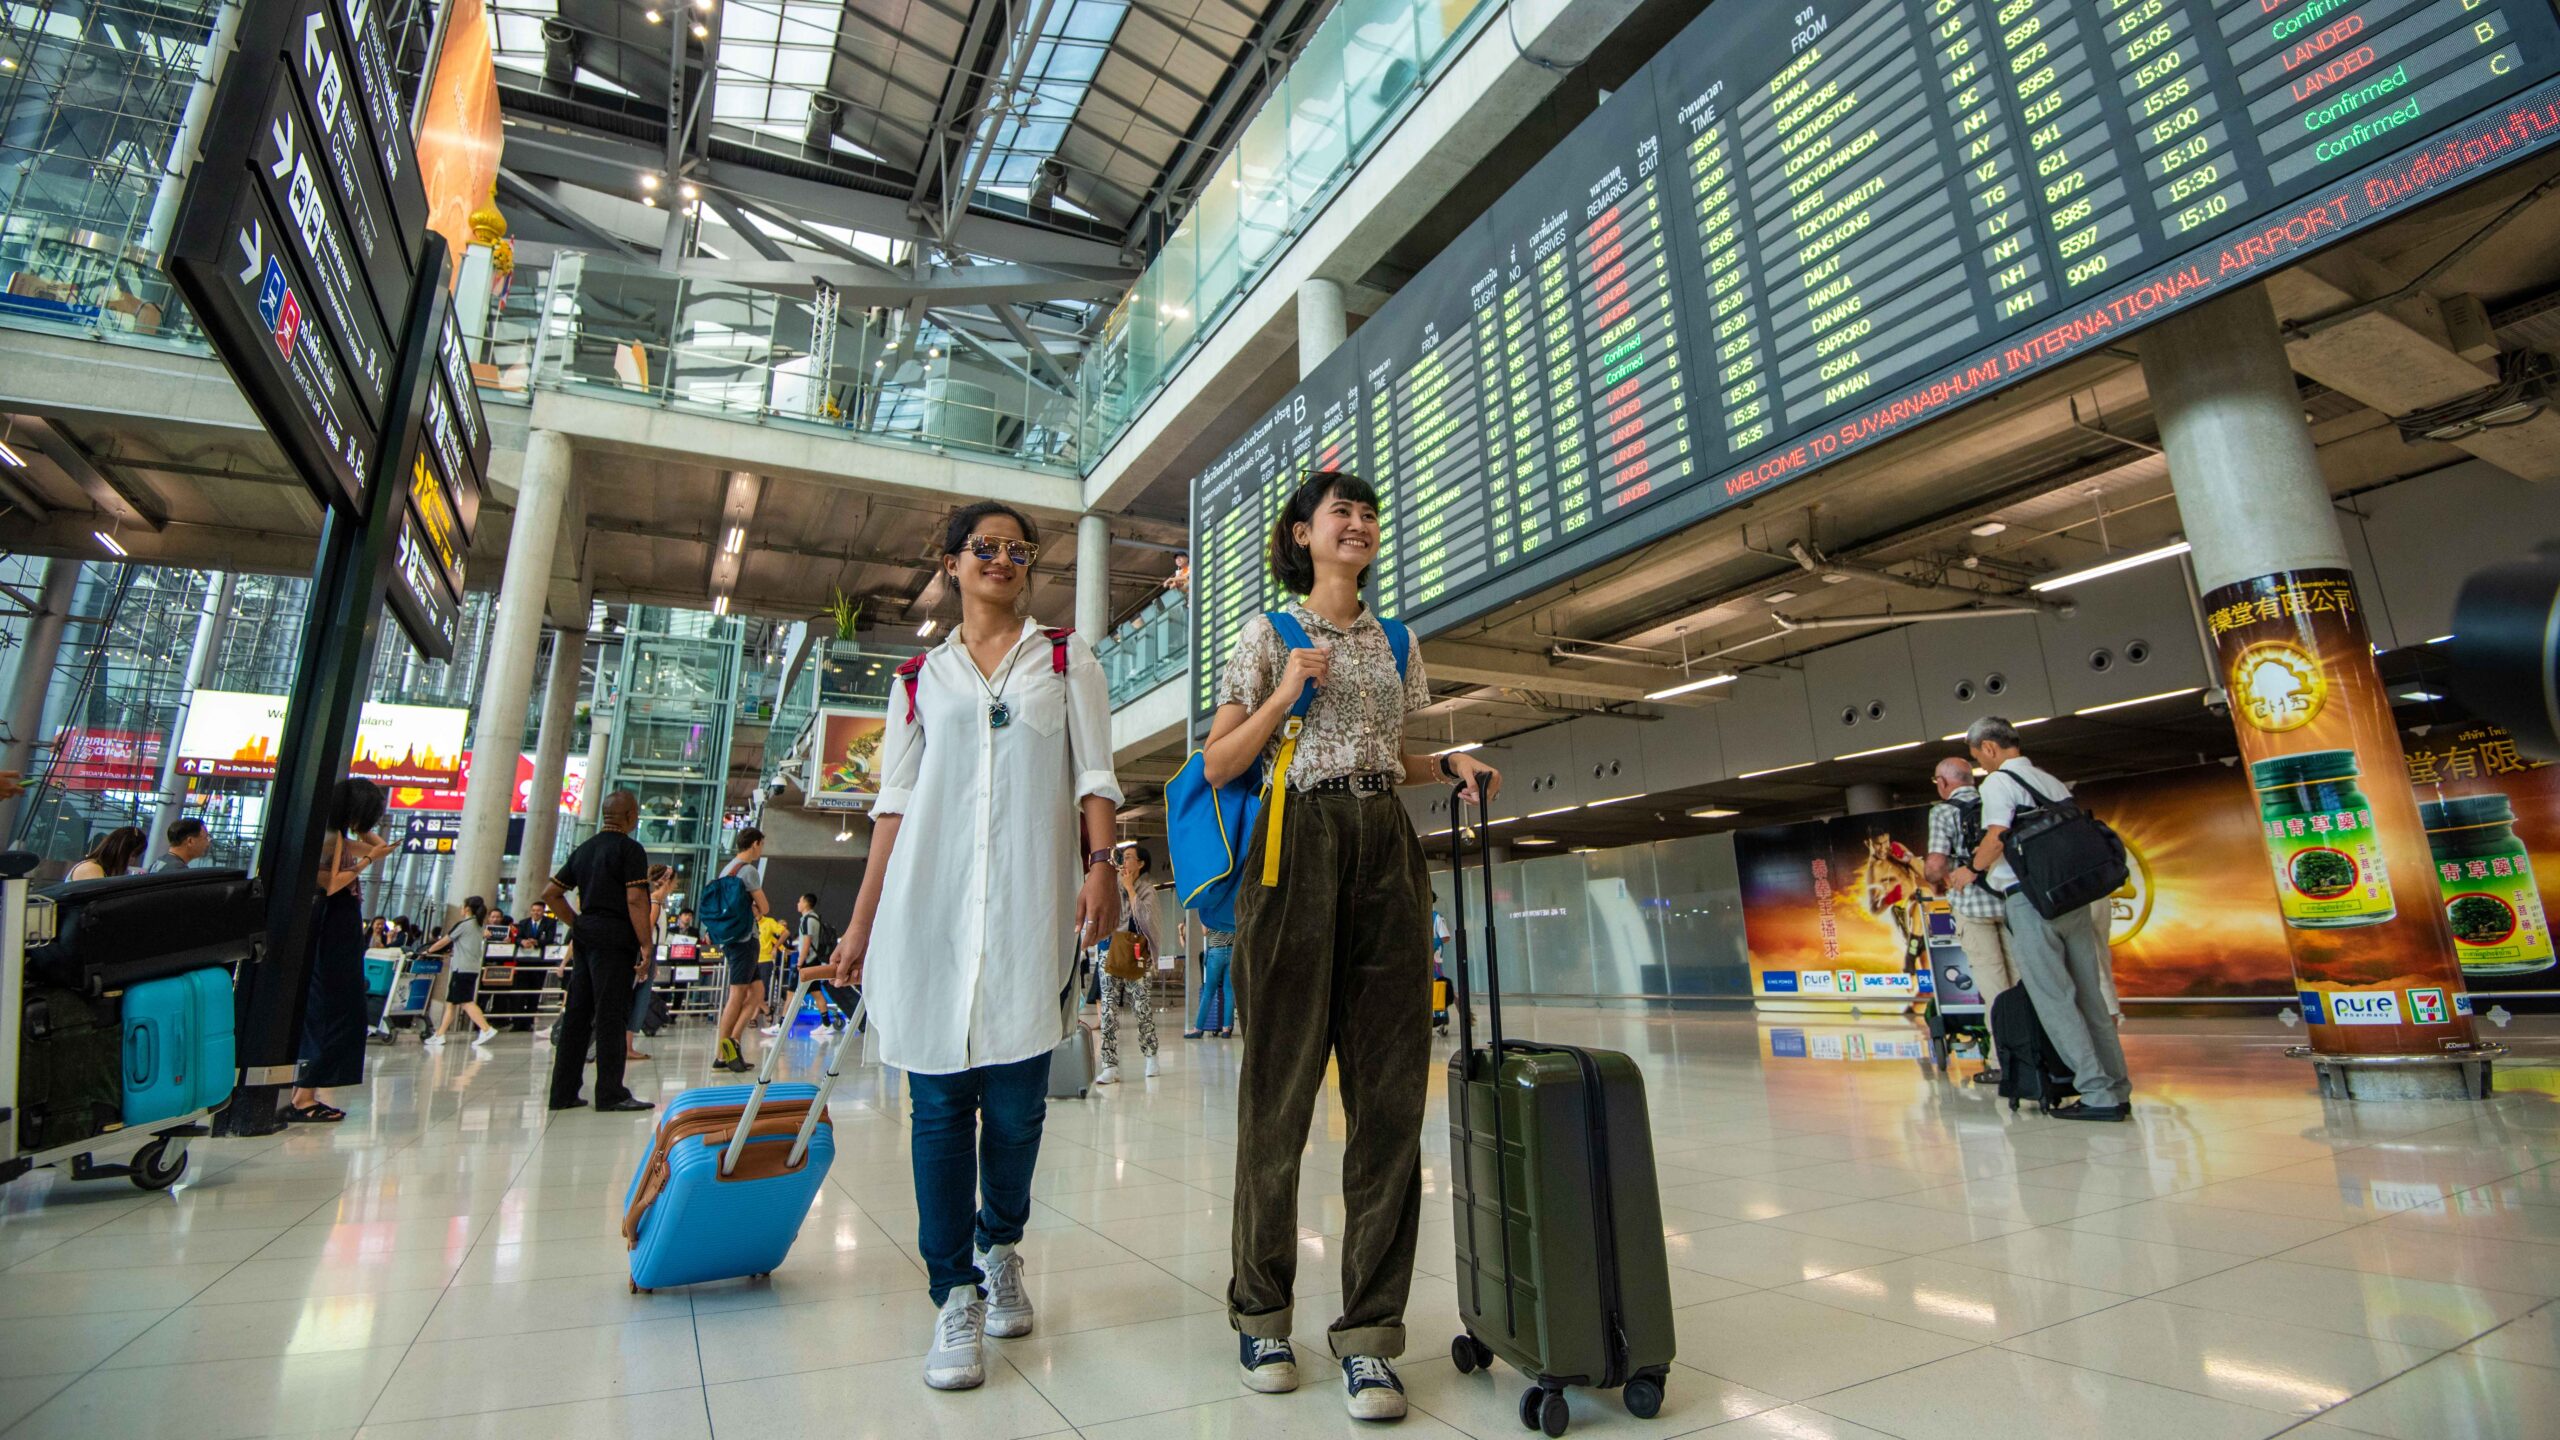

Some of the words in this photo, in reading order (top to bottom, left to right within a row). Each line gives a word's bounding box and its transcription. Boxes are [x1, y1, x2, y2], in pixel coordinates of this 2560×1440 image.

[1795, 6, 1814, 26] จาก
[359, 41, 374, 93] Group
[371, 84, 383, 124] Tour
[1691, 104, 1716, 133] TIME
[1791, 15, 1827, 53] FROM
[1693, 128, 1718, 155] 15:00
[1771, 48, 1821, 94] ISTANBUL
[1703, 186, 1728, 214] 15:05
[1782, 94, 1857, 153] VLADIVOSTOK
[1941, 17, 1962, 39] U6
[1773, 80, 1810, 115] DHAKA
[1785, 138, 1832, 177] LONDON
[1948, 39, 1969, 61] TG
[332, 132, 344, 166] Car
[340, 158, 355, 201] Rent
[1700, 168, 1724, 193] 15:00
[1776, 81, 1838, 135] SINGAPORE
[1709, 228, 1733, 254] 15:05
[1789, 133, 1879, 197] TOKYO/HANEDA
[1951, 61, 1976, 87] NH
[2003, 16, 2041, 50] 5599
[1711, 249, 1737, 275] 15:15
[1791, 190, 1825, 220] HEFEI
[1959, 87, 1979, 109] 9C
[2011, 42, 2048, 74] 8573
[1715, 270, 1740, 295] 15:20
[1798, 179, 1885, 240] TOKYO/NARITA
[1964, 109, 1988, 134] NH
[2017, 67, 2055, 99] 5953
[1718, 293, 1743, 316] 15:20
[1800, 234, 1835, 262] HONG
[1833, 212, 1871, 244] KONG
[1971, 135, 1989, 160] AY
[2023, 92, 2062, 125] 5115
[2127, 23, 2172, 61] 15:05
[1804, 256, 1838, 288] DALAT
[1976, 161, 1996, 181] VZ
[2031, 124, 2062, 150] 941
[2137, 52, 2180, 88] 15:00
[1724, 333, 1749, 359] 15:25
[1808, 278, 1853, 310] MANILA
[1983, 187, 2005, 208] TG
[2038, 153, 2068, 177] 621
[2144, 78, 2190, 116] 15:55
[1727, 358, 1753, 381] 15:25
[1814, 298, 1861, 331] DANANG
[1988, 212, 2008, 235] LY
[2045, 173, 2085, 204] 8472
[2155, 108, 2198, 144] 15:00
[2283, 15, 2363, 71] LANDED
[1731, 380, 1757, 404] 15:30
[1817, 321, 1871, 356] SAPPORO
[1994, 239, 2019, 260] NH
[2052, 199, 2092, 231] 5985
[2160, 137, 2208, 173] 15:10
[2293, 47, 2374, 101] LANDED
[1733, 405, 1758, 425] 15:35
[1821, 352, 1859, 379] OSAKA
[1999, 267, 2026, 289] NH
[2059, 229, 2097, 258] 5597
[2171, 166, 2216, 201] 15:30
[2303, 64, 2409, 132] Confirmed
[2475, 21, 2494, 44] B
[1737, 425, 1762, 449] 15:35
[1825, 373, 1870, 404] AMMAN
[2006, 290, 2034, 316] MH
[2066, 256, 2107, 287] 9040
[2179, 196, 2227, 229] 15:10
[2313, 96, 2422, 164] Confirmed
[2489, 54, 2509, 75] C
[314, 252, 327, 283] Public
[1421, 331, 1439, 354] FROM
[1474, 283, 1497, 311] FLIGHT
[1509, 265, 1521, 282] NO
[1534, 228, 1566, 263] ARRIVES
[1587, 177, 1628, 219] REMARKS
[1639, 151, 1658, 177] EXIT
[1598, 281, 1627, 309] LANDED
[1601, 317, 1637, 347] DELAYED
[1662, 296, 1669, 308] B
[1601, 331, 1644, 369] Confirmed
[1664, 315, 1670, 327] C
[1604, 351, 1646, 387] Confirmed
[1726, 449, 1808, 497] WELCOME
[1810, 435, 1837, 461] TO
[1840, 358, 2001, 445] SUVARNABHUMI
[2004, 265, 2210, 372] INTERNATIONAL
[2218, 194, 2351, 276] AIRPORT
[290, 356, 306, 388] Airport
[304, 379, 314, 402] Rail
[311, 394, 322, 418] Link
[1294, 394, 1306, 426] B
[1322, 410, 1344, 435] REMARKS
[1254, 442, 1271, 460] Door
[1420, 582, 1444, 603] LONDON
[1618, 482, 1651, 506] LANDED
[1682, 462, 1690, 474] B
[820, 799, 861, 808] JCDecaux
[1804, 975, 1831, 986] pure
[1863, 977, 1884, 986] SAVE
[1886, 977, 1909, 986] DRUG
[2335, 997, 2393, 1017] pure
